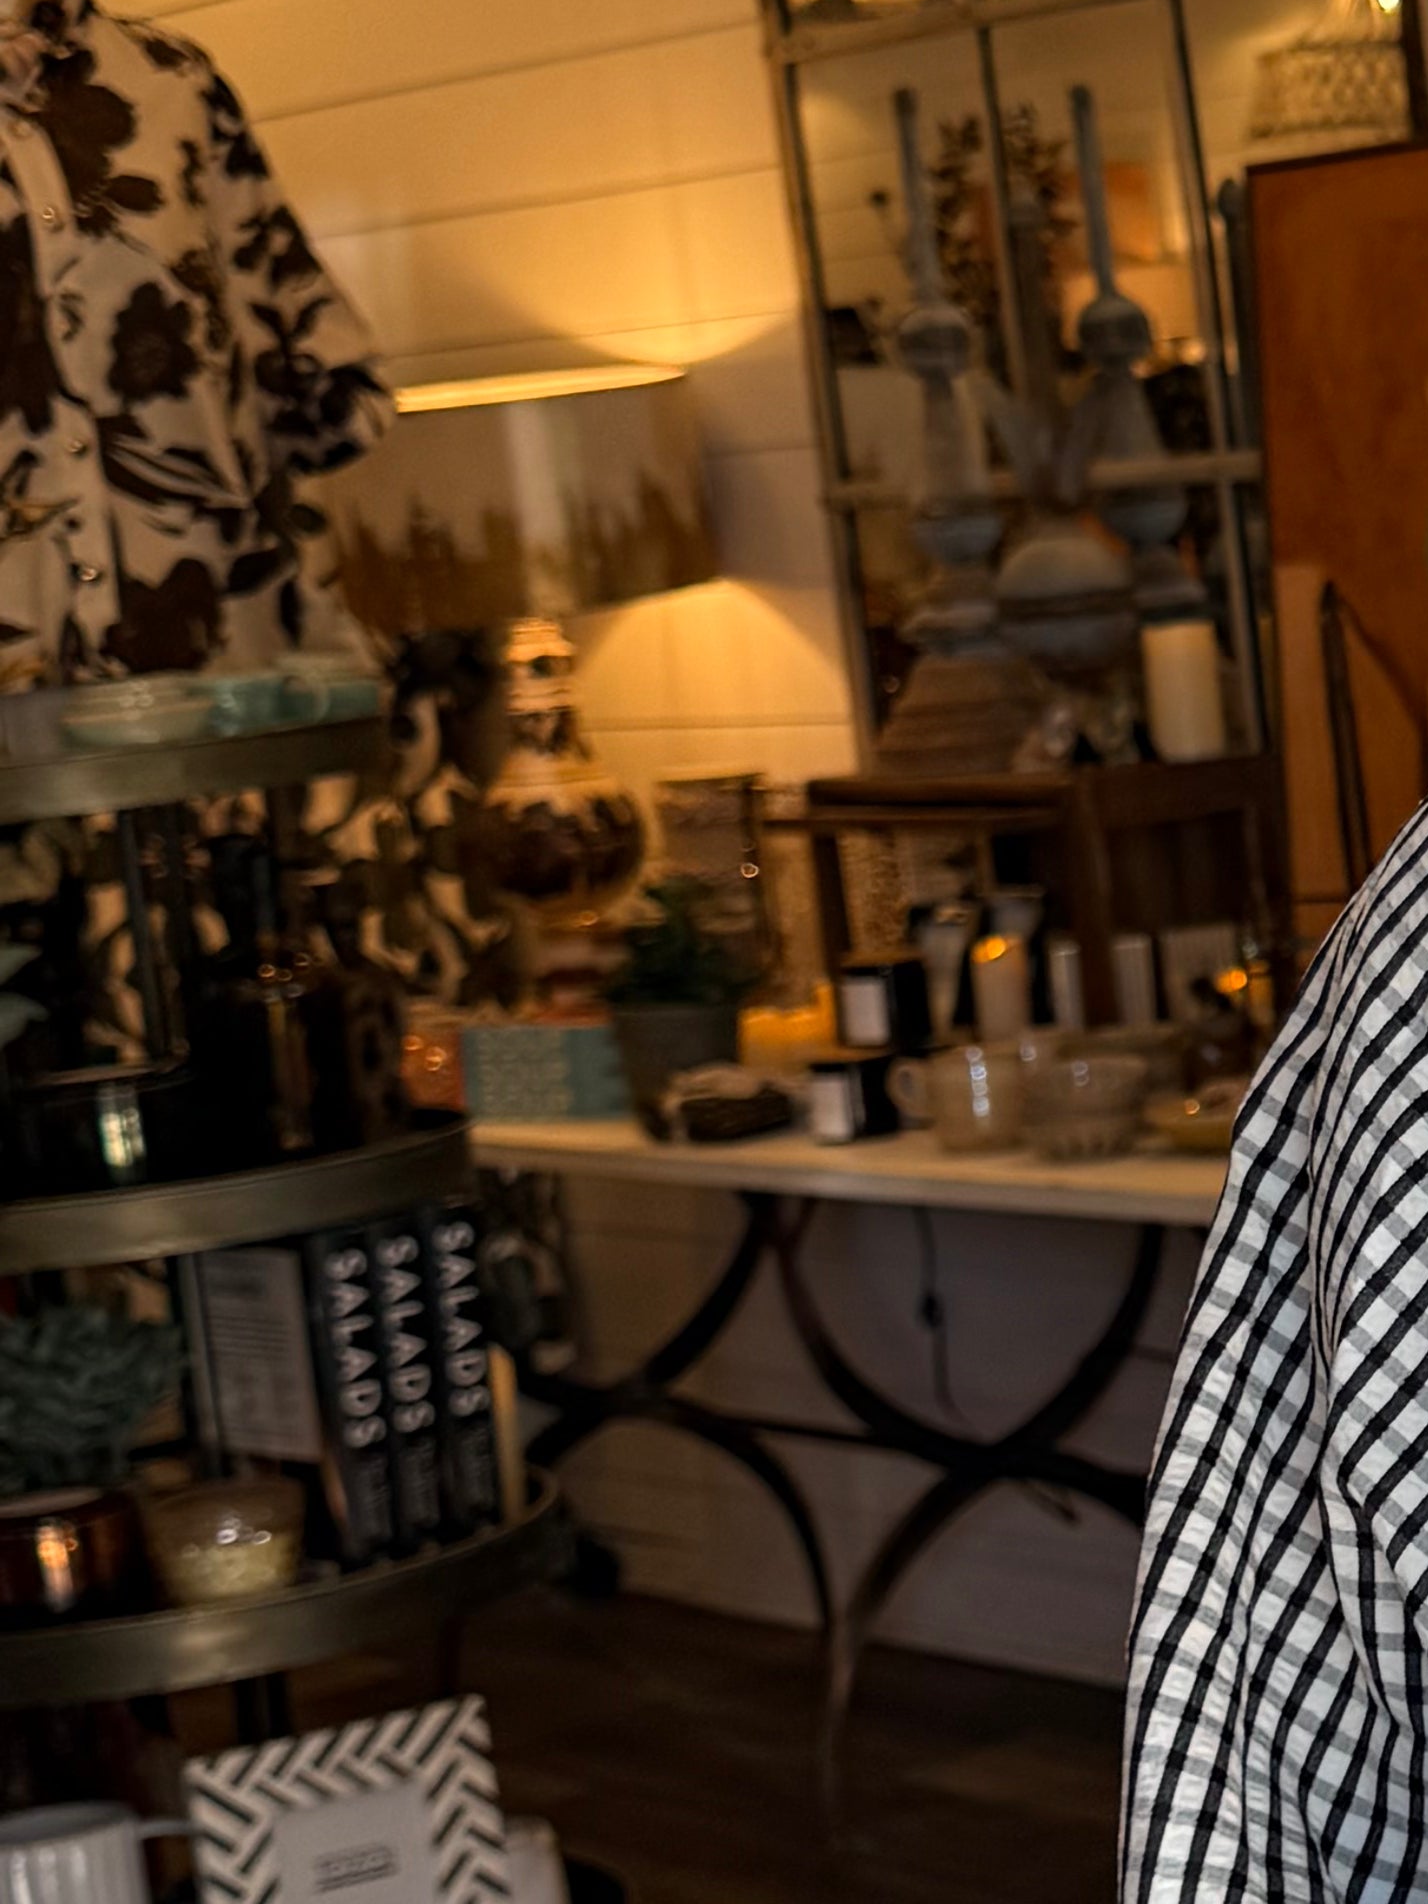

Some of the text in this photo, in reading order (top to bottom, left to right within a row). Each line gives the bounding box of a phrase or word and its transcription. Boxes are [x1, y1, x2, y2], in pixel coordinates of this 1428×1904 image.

[325, 1248, 387, 1448] SALADS
[376, 1235, 435, 1433] SALADS
[433, 1221, 490, 1417] SALADS
